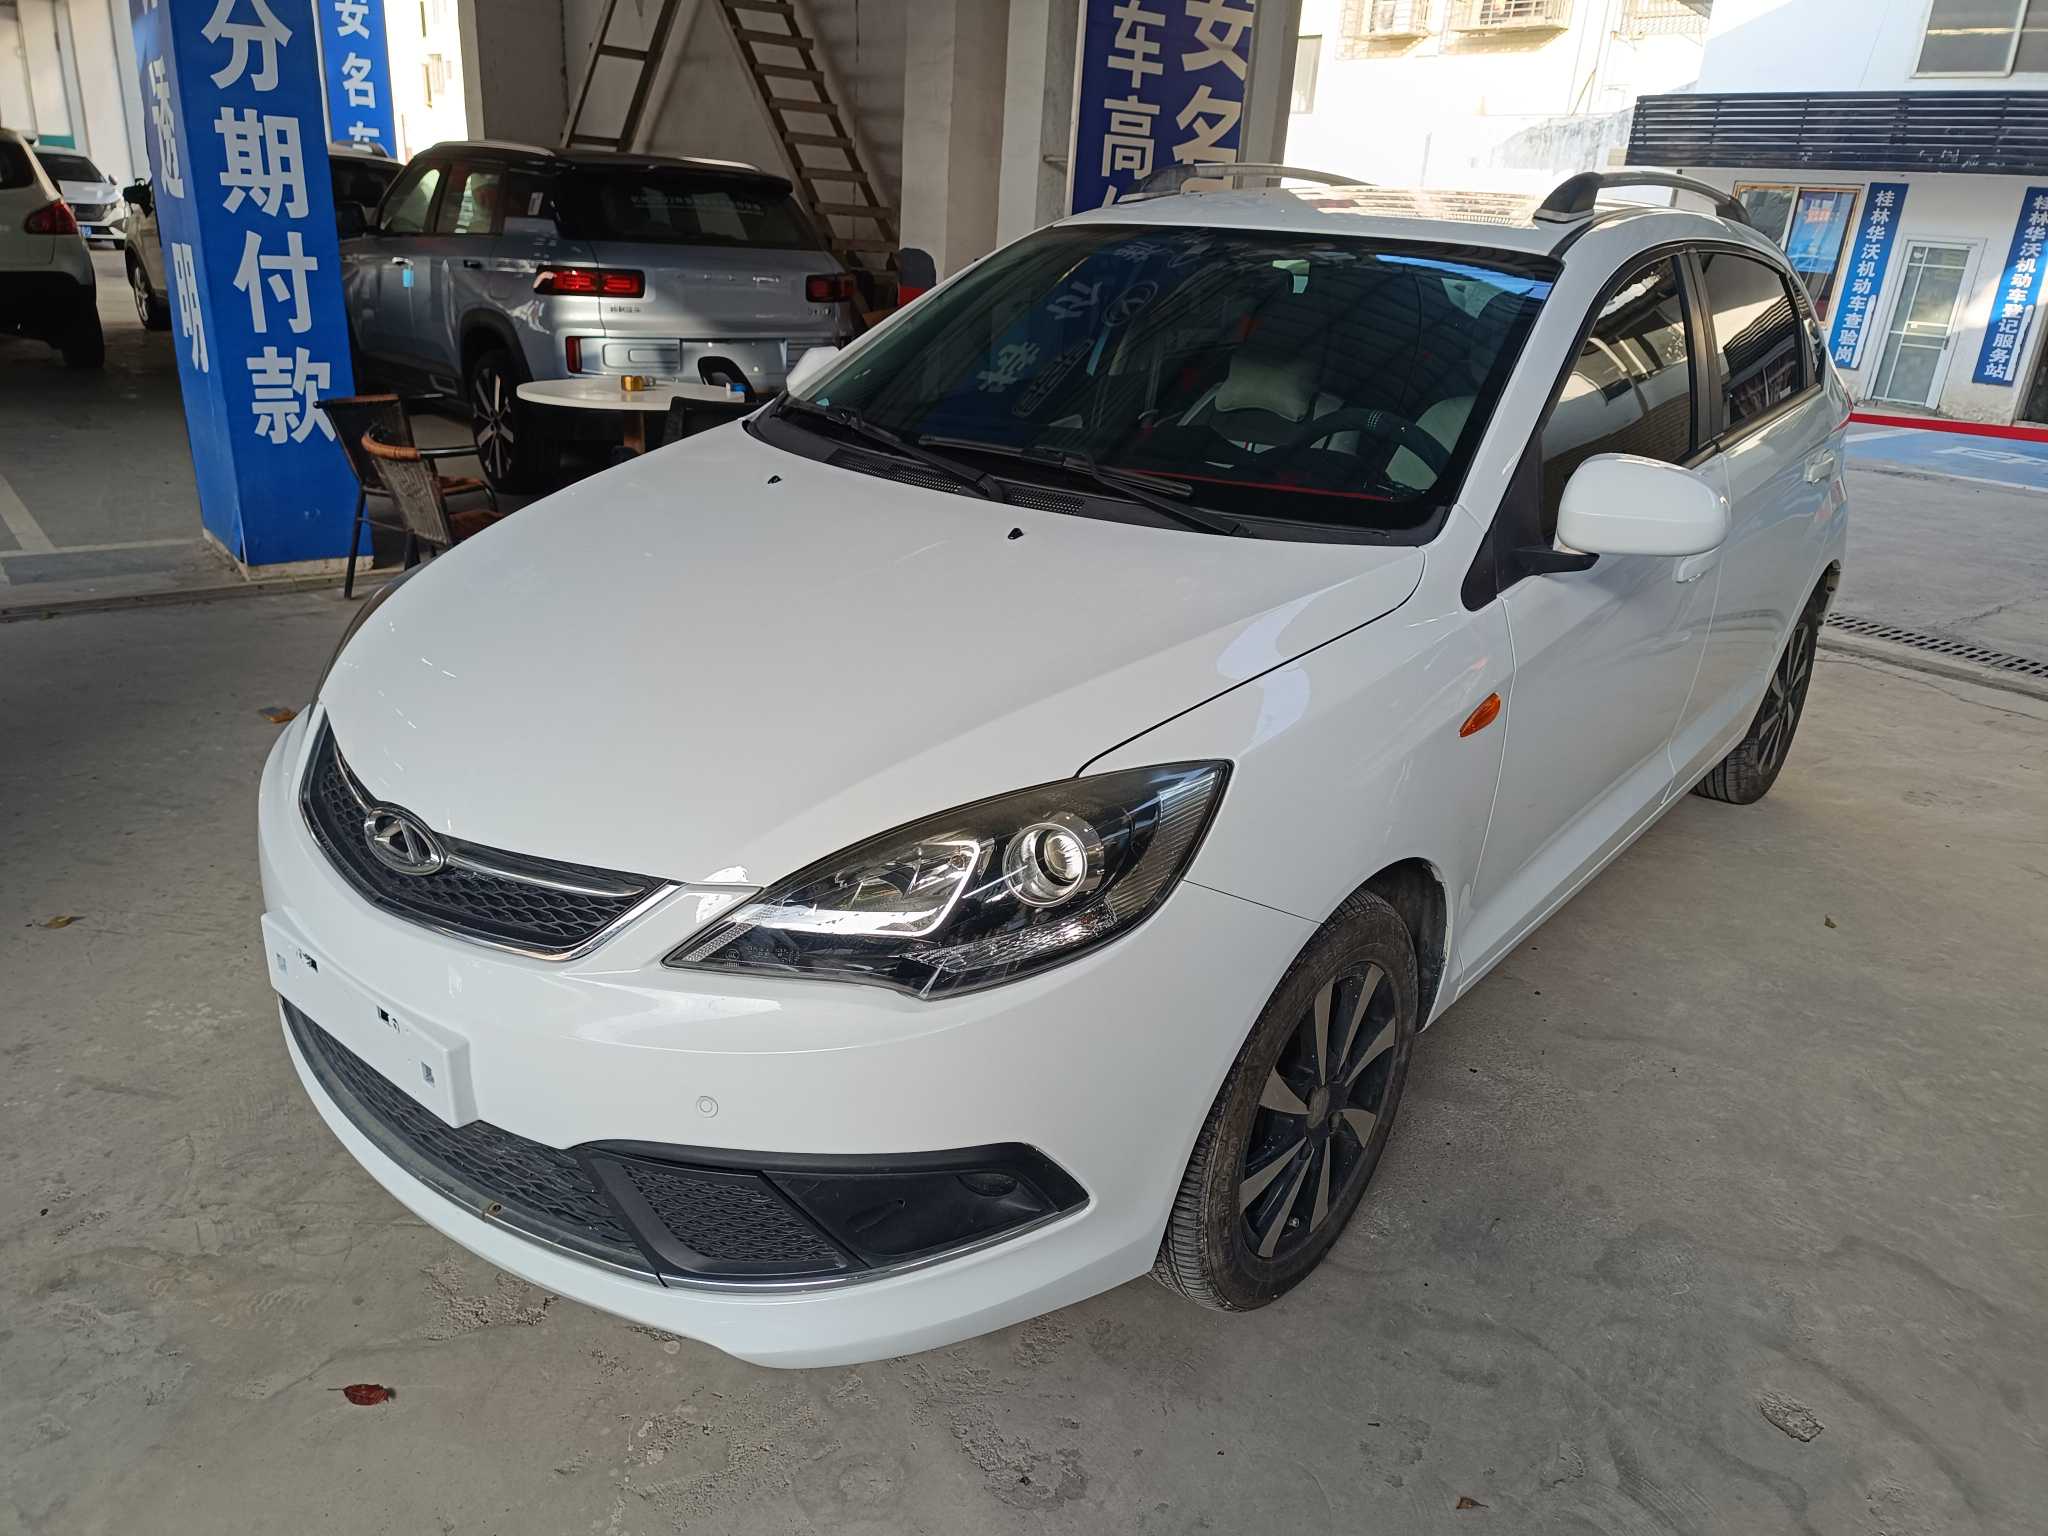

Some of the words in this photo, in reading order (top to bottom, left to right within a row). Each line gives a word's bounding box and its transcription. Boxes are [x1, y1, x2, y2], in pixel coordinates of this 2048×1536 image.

[143, 0, 210, 373] 透明
[1101, 0, 1166, 207] 车高
[201, 0, 336, 444] 分期付款
[1835, 190, 1896, 363] 桂林华沃机动车查验岗
[1984, 195, 2048, 379] 桂林华沃机动车登记服务站
